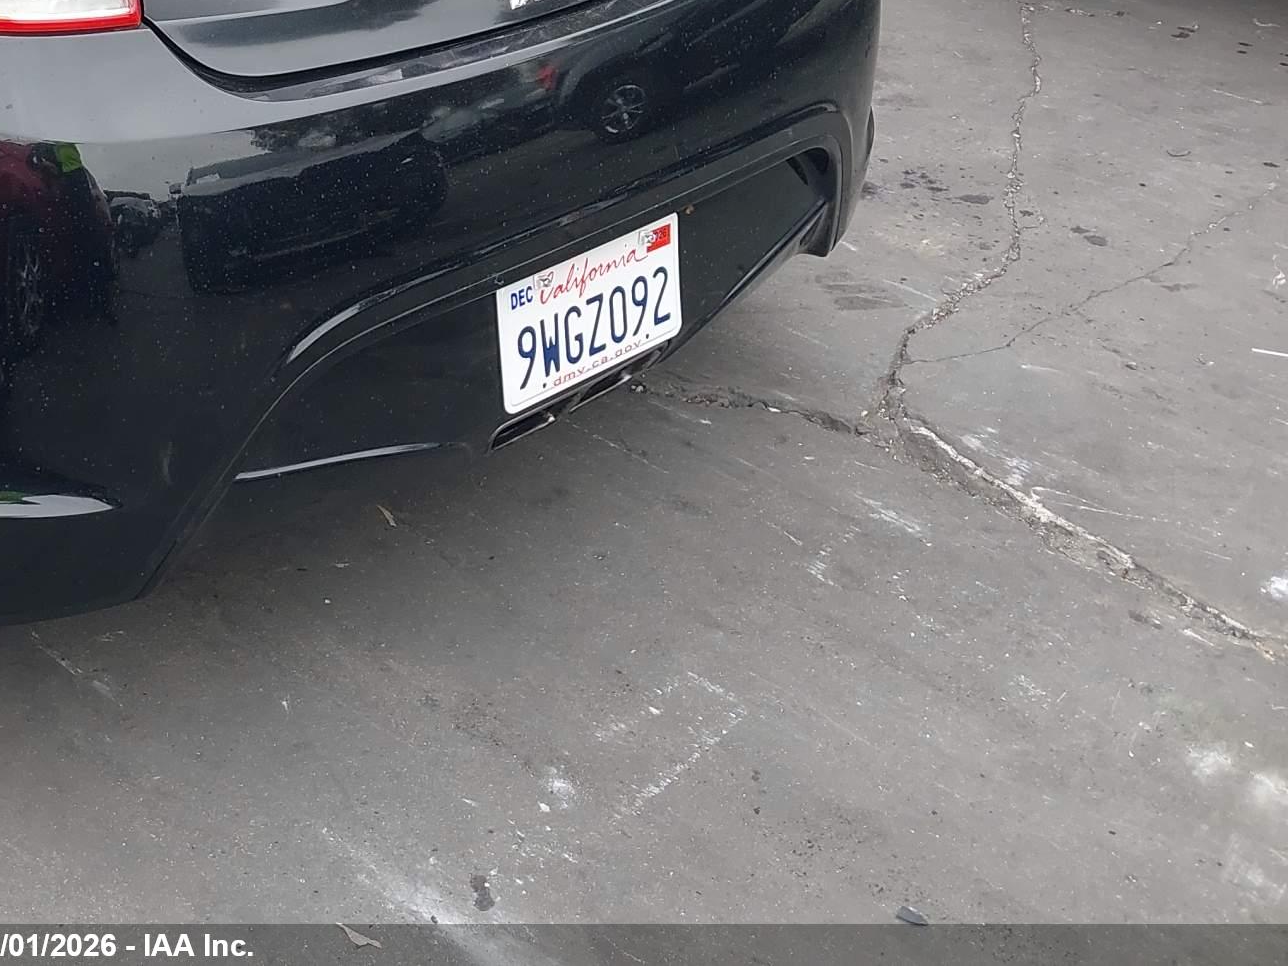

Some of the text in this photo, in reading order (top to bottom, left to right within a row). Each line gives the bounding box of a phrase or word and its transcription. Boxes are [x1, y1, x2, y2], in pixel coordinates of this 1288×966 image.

[511, 286, 534, 310] DEC
[540, 244, 648, 305] California
[517, 266, 671, 390] 9WGZ092
